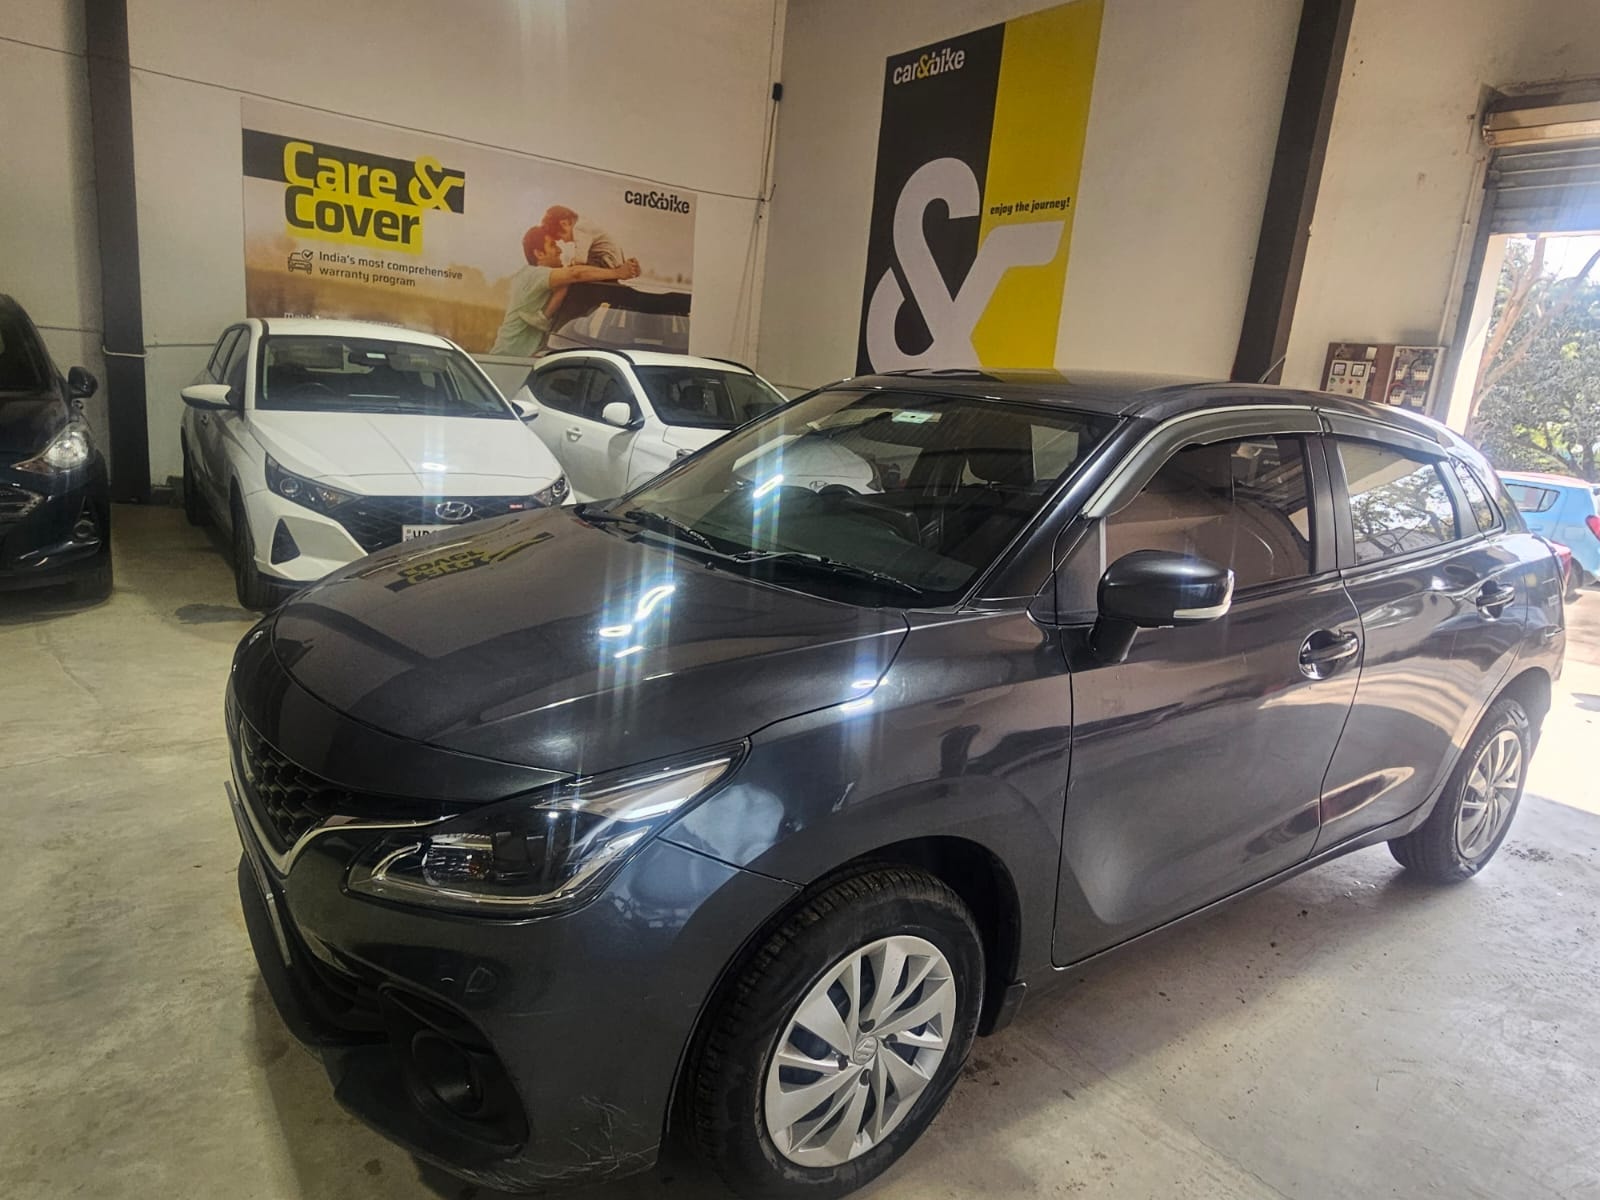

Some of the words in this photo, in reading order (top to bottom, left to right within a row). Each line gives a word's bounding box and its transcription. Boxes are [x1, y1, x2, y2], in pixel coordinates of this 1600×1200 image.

[893, 47, 965, 85] car&bike
[283, 140, 397, 201] Care
[408, 154, 465, 211] &
[284, 185, 420, 244] Cover
[624, 190, 690, 214] car&bike
[990, 203, 1013, 216] enjoy
[1015, 201, 1030, 212] the
[1030, 196, 1071, 213] journey!
[319, 251, 355, 265] India's
[358, 258, 385, 269] most
[387, 261, 463, 281] comprehensive
[319, 266, 370, 283] warranty
[372, 273, 416, 288] program
